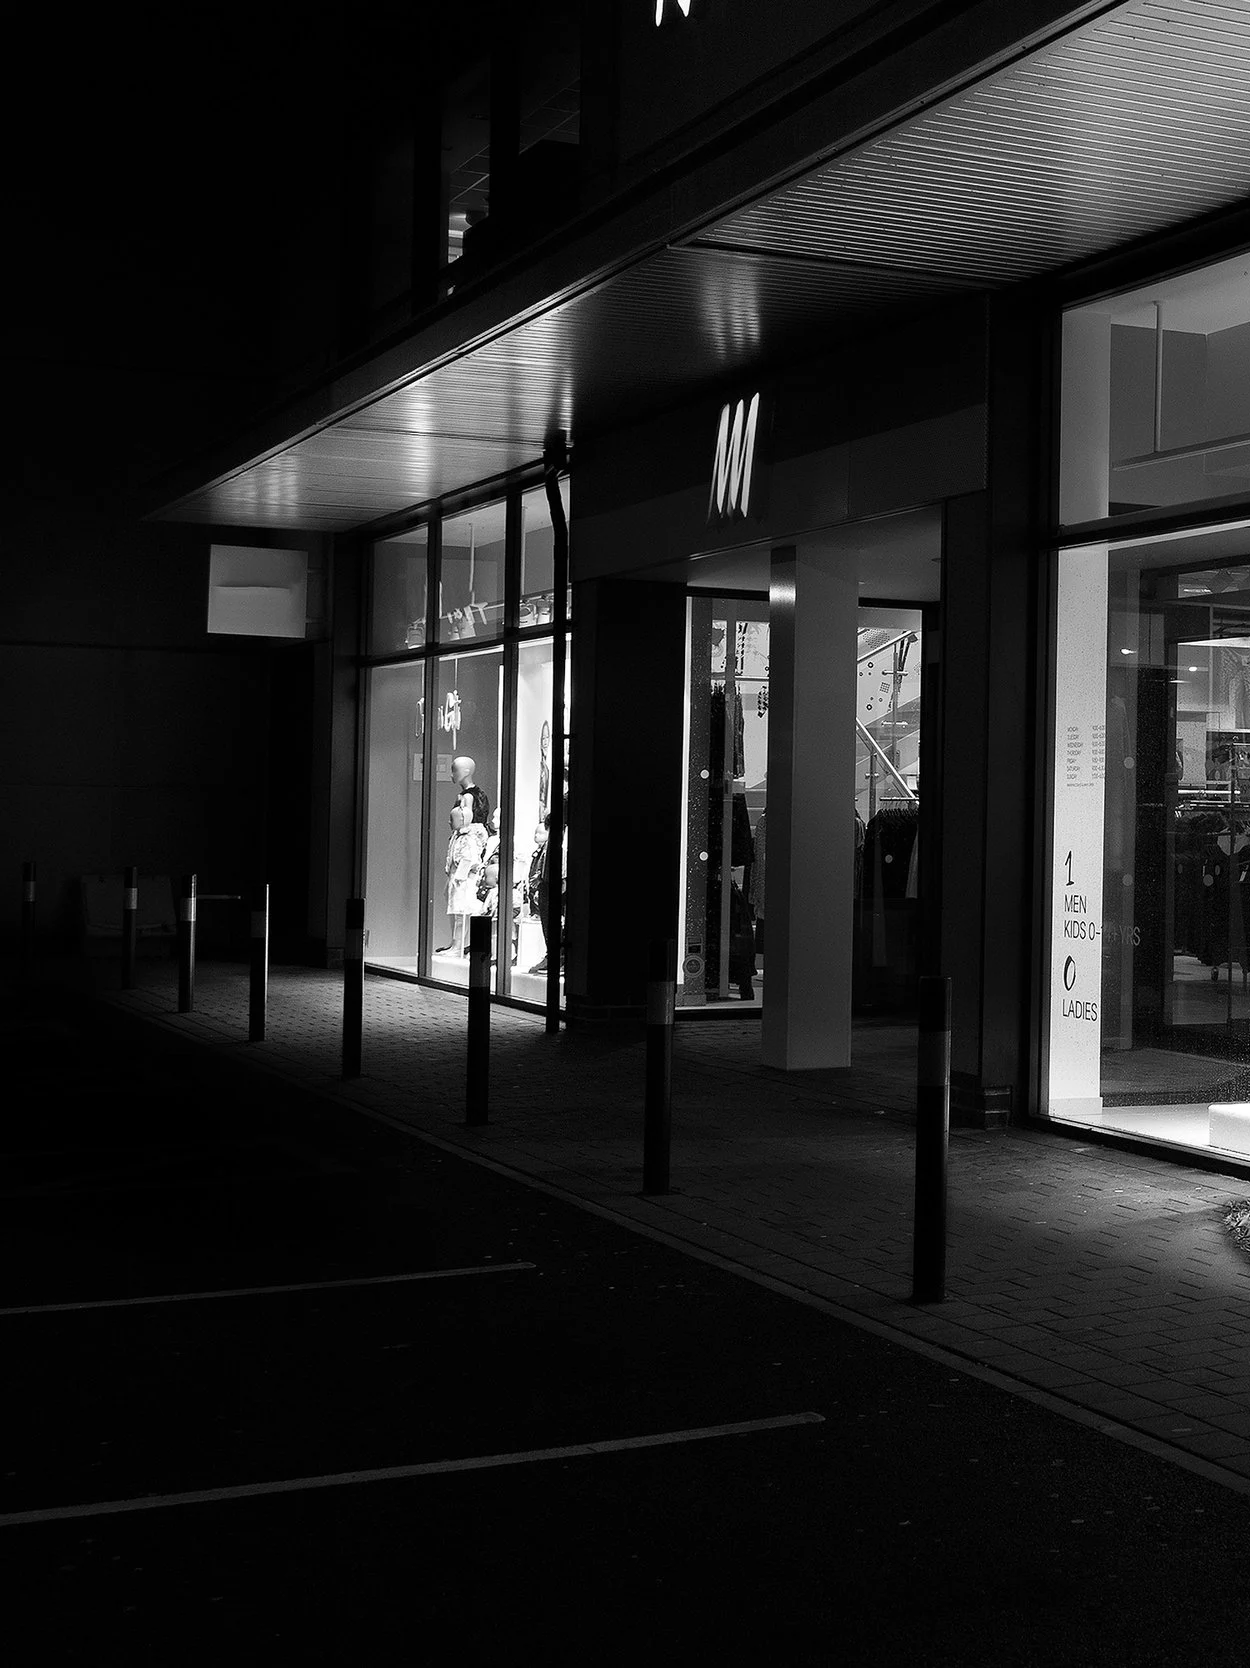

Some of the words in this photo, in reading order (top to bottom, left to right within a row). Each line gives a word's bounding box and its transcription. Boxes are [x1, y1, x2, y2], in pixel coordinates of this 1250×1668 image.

[1064, 850, 1075, 886] 1
[1064, 894, 1087, 914] MEN
[1063, 919, 1087, 940] KIDS
[1062, 998, 1098, 1022] LADIES
